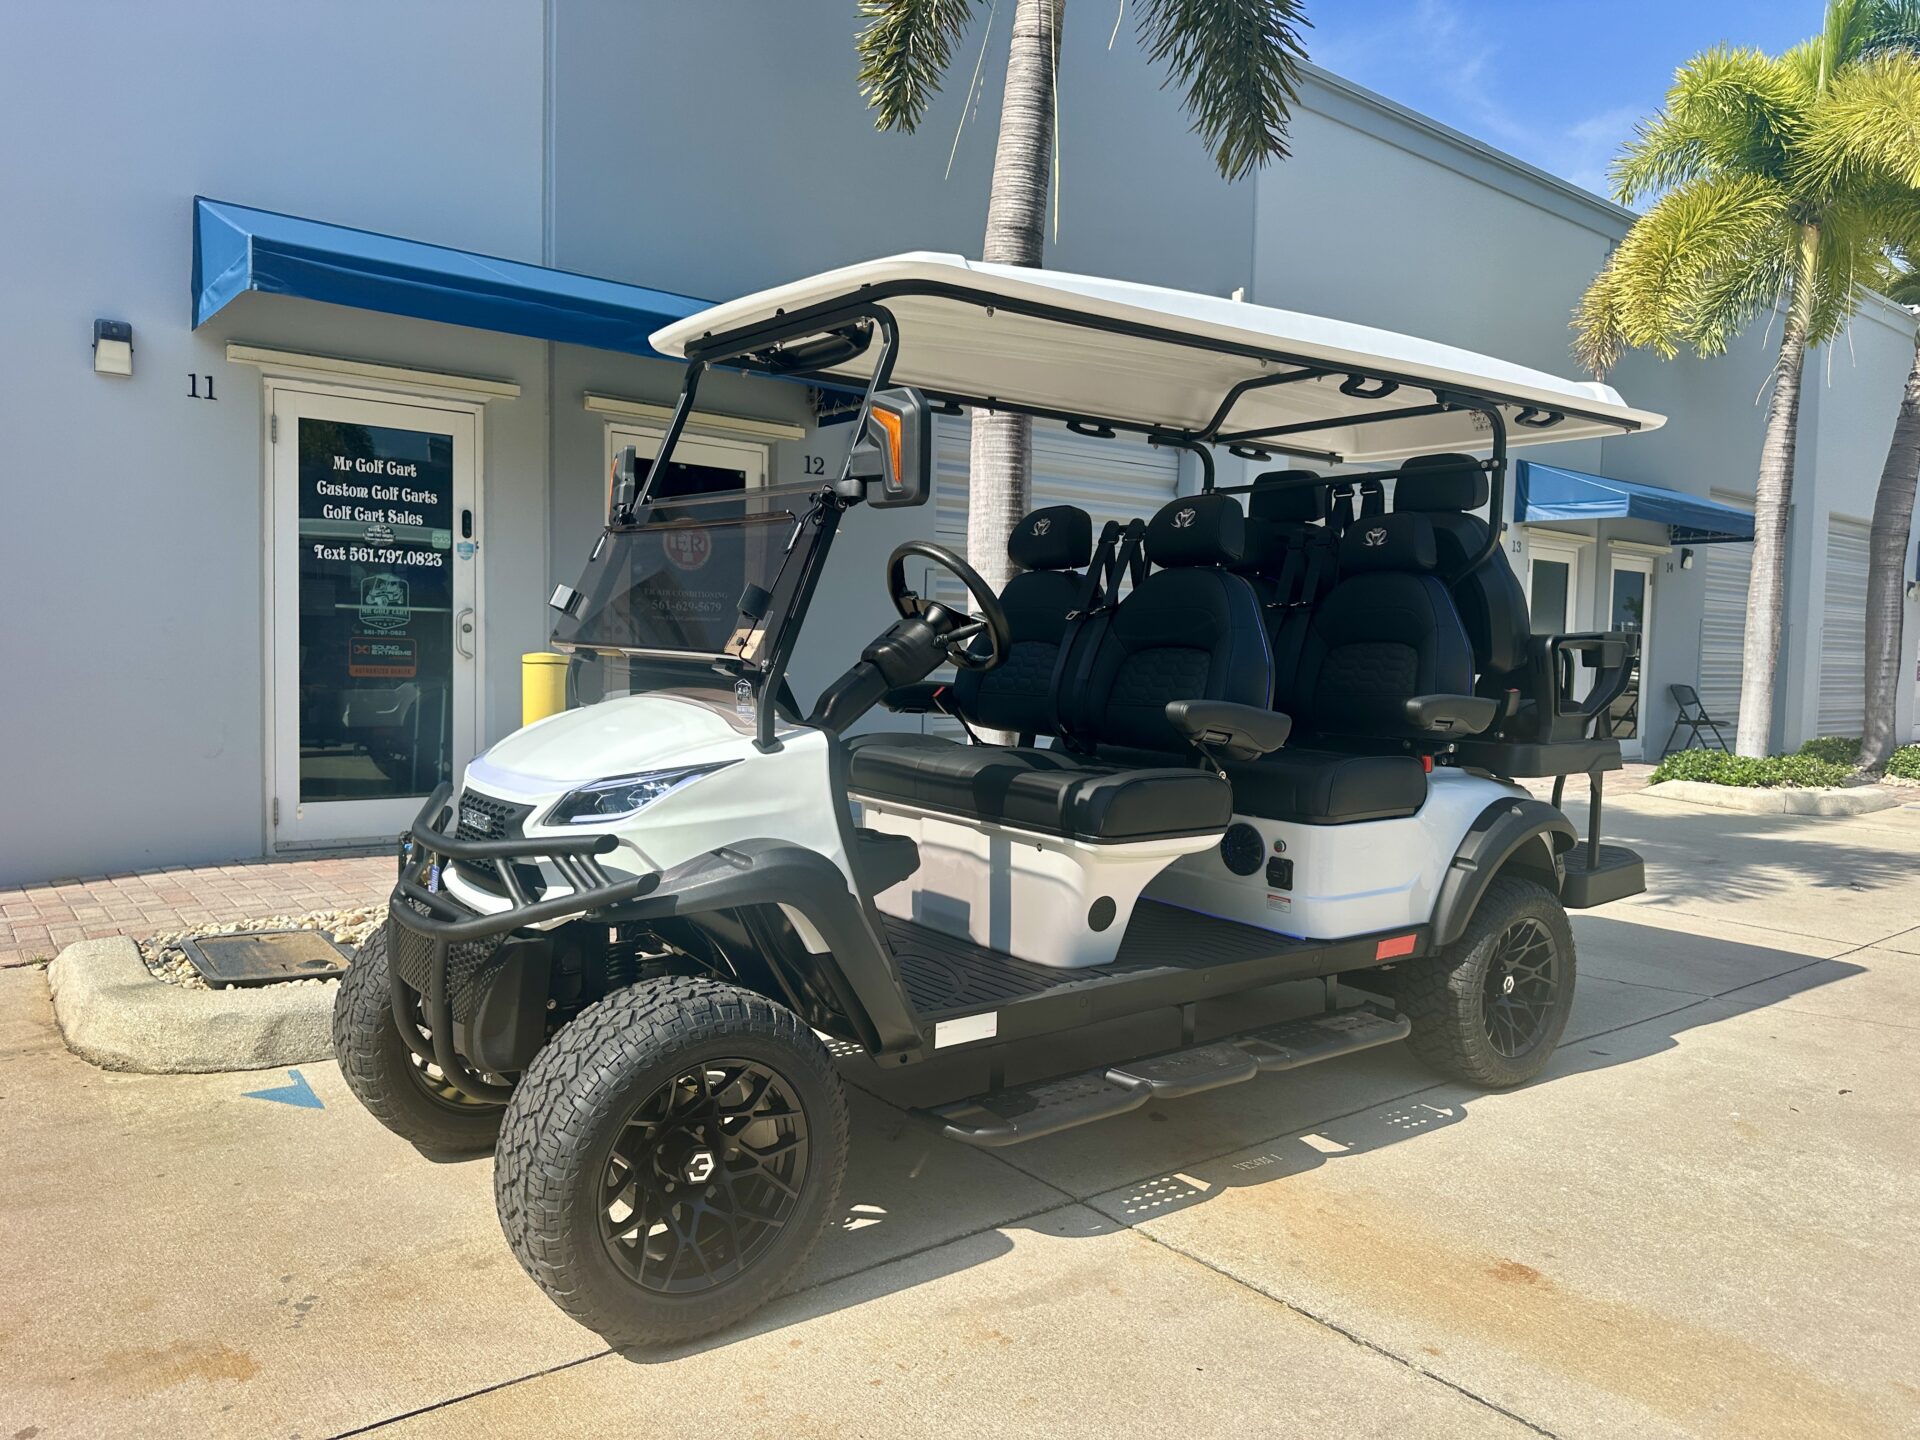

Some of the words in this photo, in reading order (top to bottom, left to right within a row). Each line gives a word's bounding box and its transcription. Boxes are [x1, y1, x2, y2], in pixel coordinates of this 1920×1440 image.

[187, 373, 218, 400] 11
[333, 455, 353, 471] Mr
[355, 457, 384, 474] Golf
[386, 461, 417, 477] Cart
[804, 455, 825, 475] 12
[316, 480, 368, 498] Custom
[371, 485, 399, 501] Golf
[401, 488, 438, 504] Carts
[323, 504, 351, 520] Golf
[354, 507, 385, 523] Cart
[387, 509, 423, 525] Sales
[313, 544, 347, 560] Text
[349, 547, 443, 567] 561.797.0823
[1511, 540, 1522, 553] 13
[1666, 562, 1674, 573] 14
